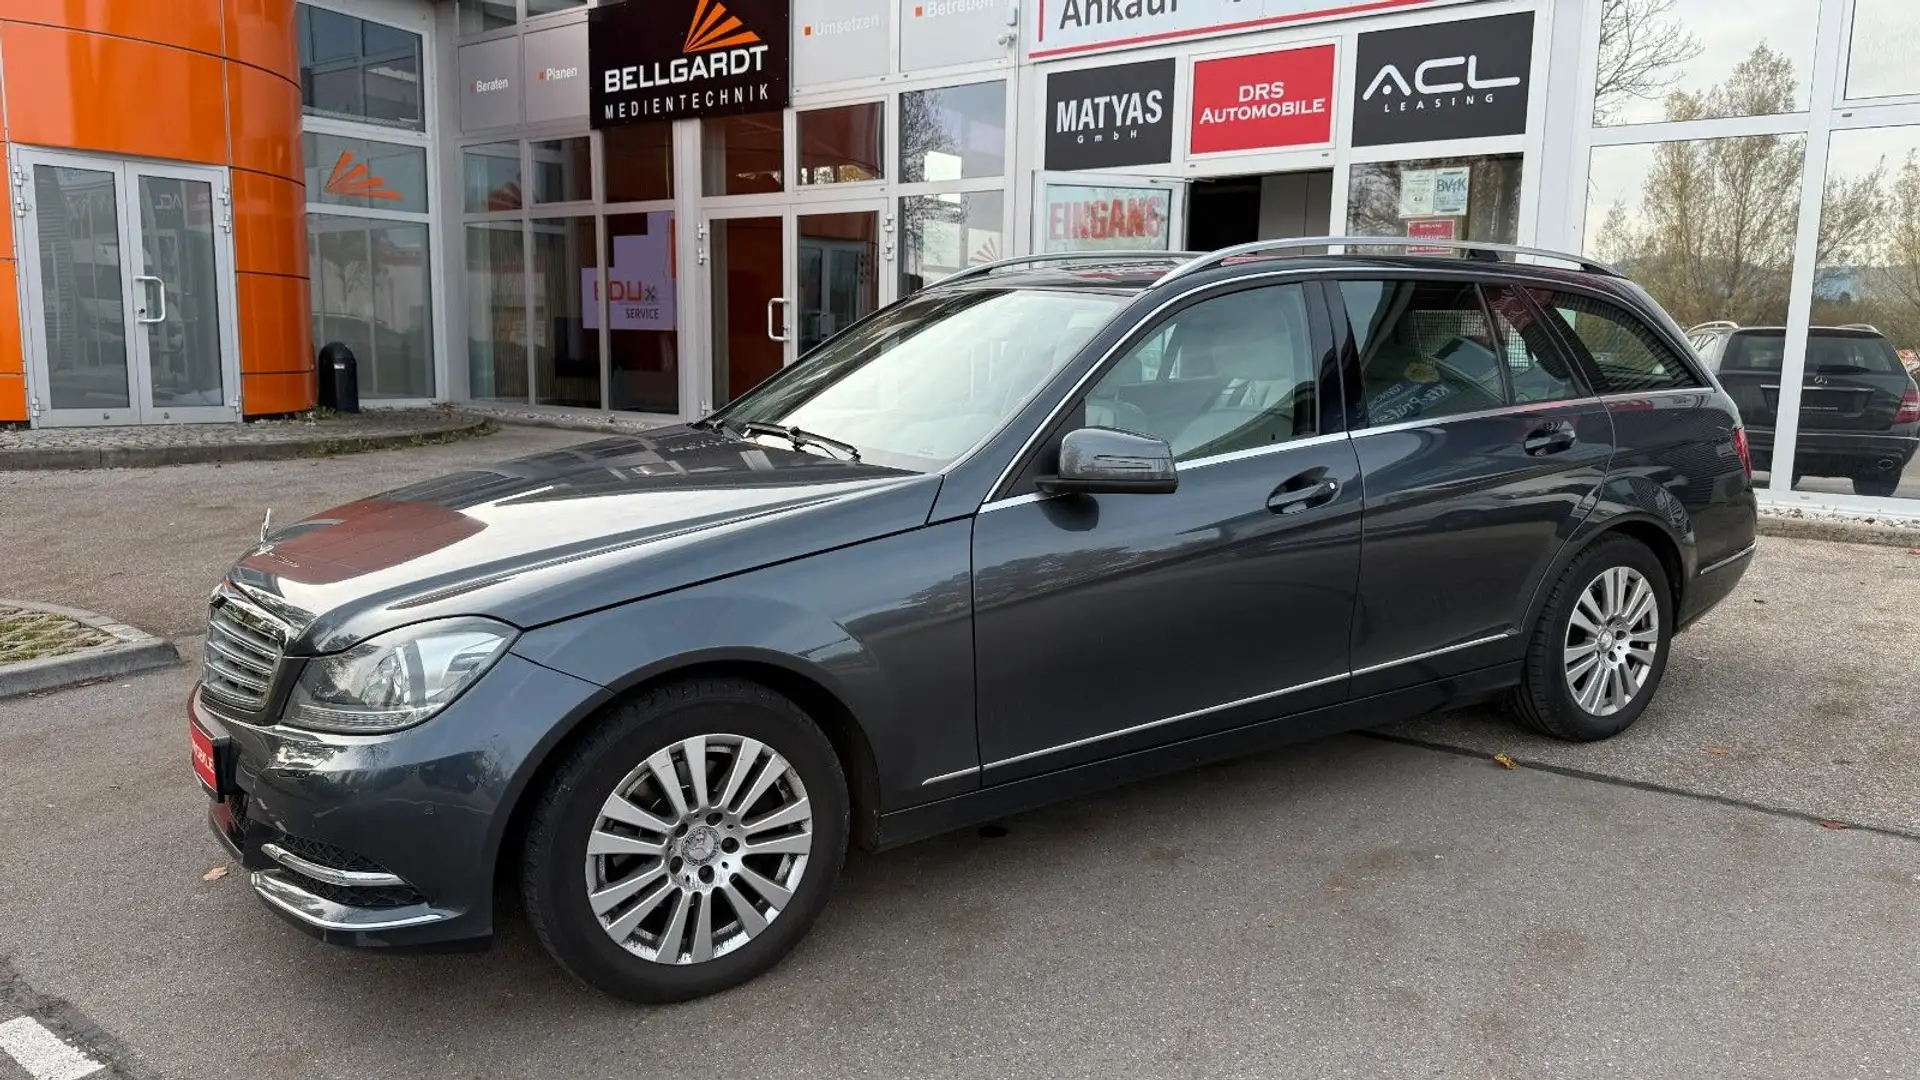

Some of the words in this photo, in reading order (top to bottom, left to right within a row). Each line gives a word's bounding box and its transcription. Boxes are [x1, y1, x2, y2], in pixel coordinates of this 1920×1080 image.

[814, 12, 880, 37] Umsetzen
[546, 66, 578, 81] Planen
[604, 45, 769, 94] BELLGARDT
[1362, 55, 1521, 101] ACL
[476, 77, 509, 93] Beraten
[1239, 81, 1285, 104] DRS
[604, 82, 771, 120] MEDIENTECHNIK
[1055, 88, 1164, 134] MATYAS
[1384, 93, 1495, 113] LEASING
[1049, 196, 1164, 240] EINGANG
[625, 307, 660, 320] SERVICE
